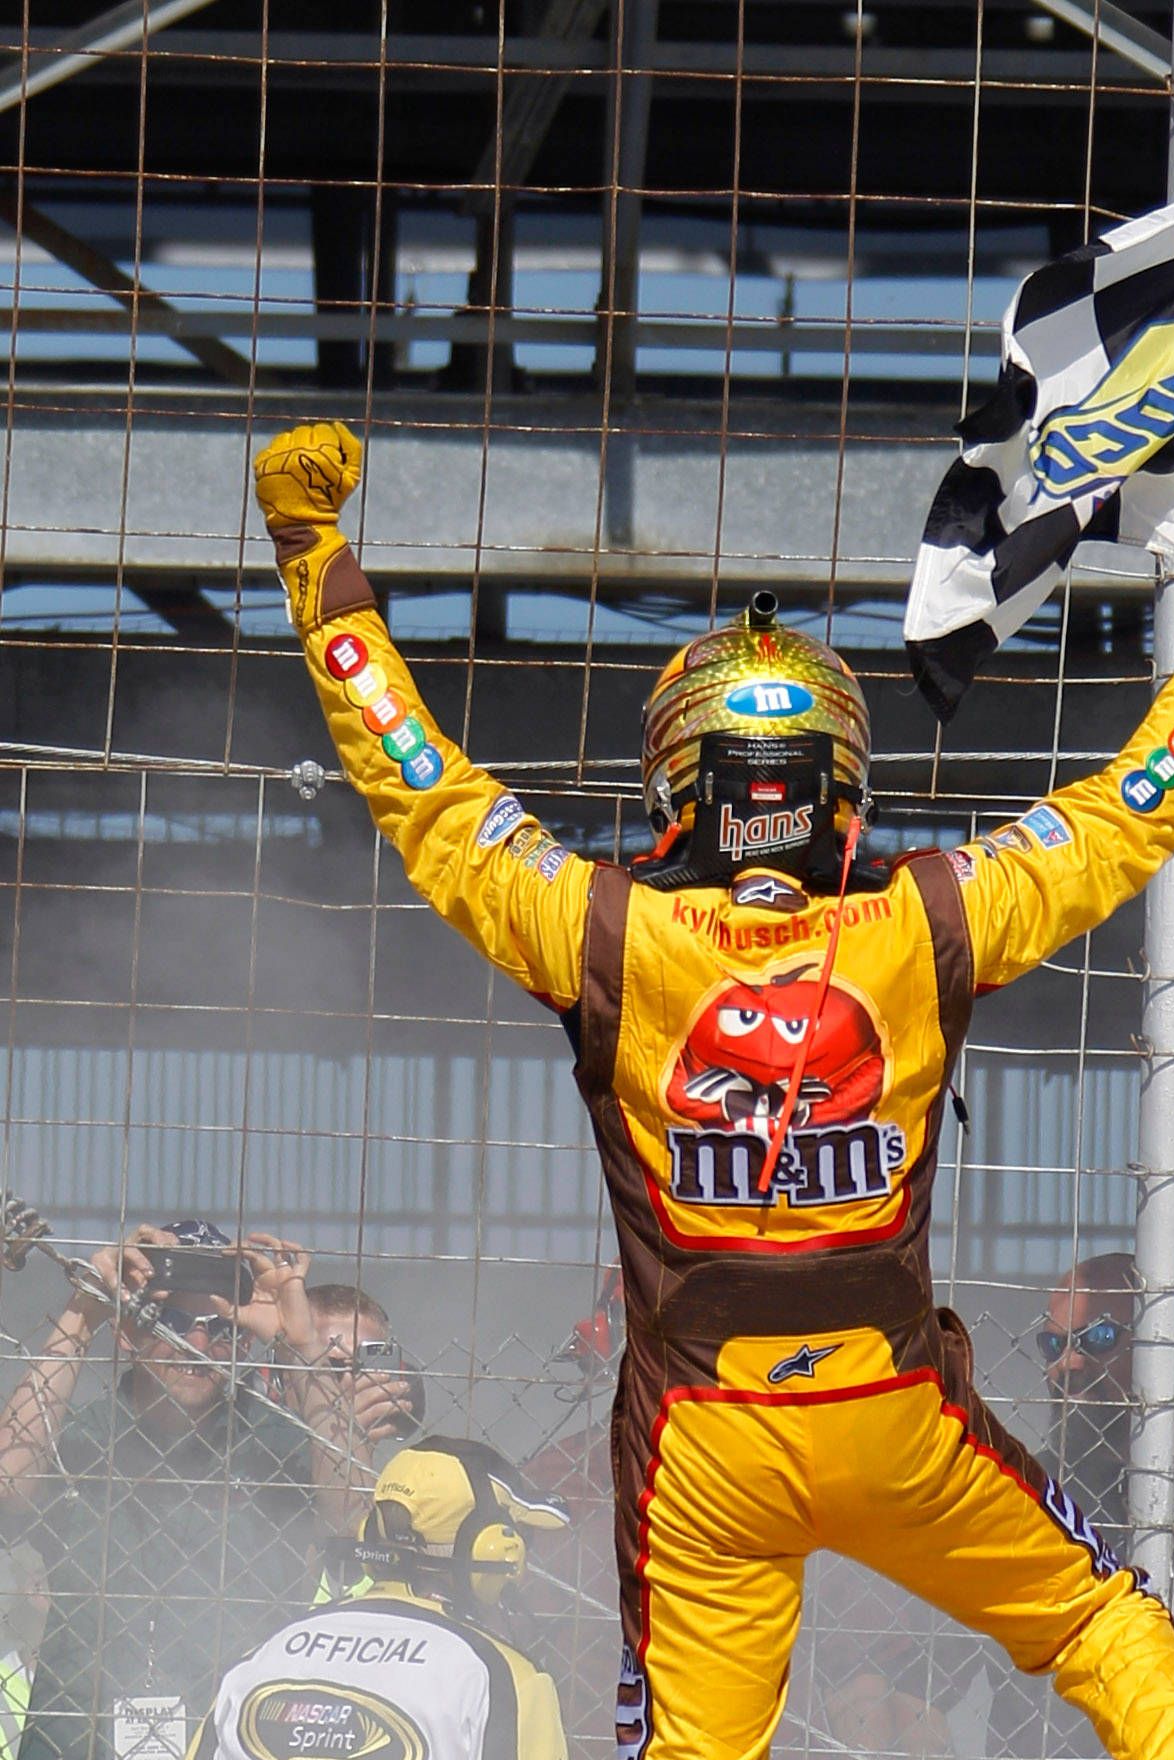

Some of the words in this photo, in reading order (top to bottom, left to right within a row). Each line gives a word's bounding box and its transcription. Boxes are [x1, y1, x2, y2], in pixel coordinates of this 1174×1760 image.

[754, 685, 793, 713] m
[747, 758, 788, 766] SERIES
[719, 803, 814, 861] hans
[671, 895, 893, 952] kylbusch.com
[354, 1547, 391, 1564] Sprint
[285, 1631, 428, 1664] OFFICIAL
[285, 1703, 353, 1726] NASCAR
[289, 1726, 356, 1753] Sprint
